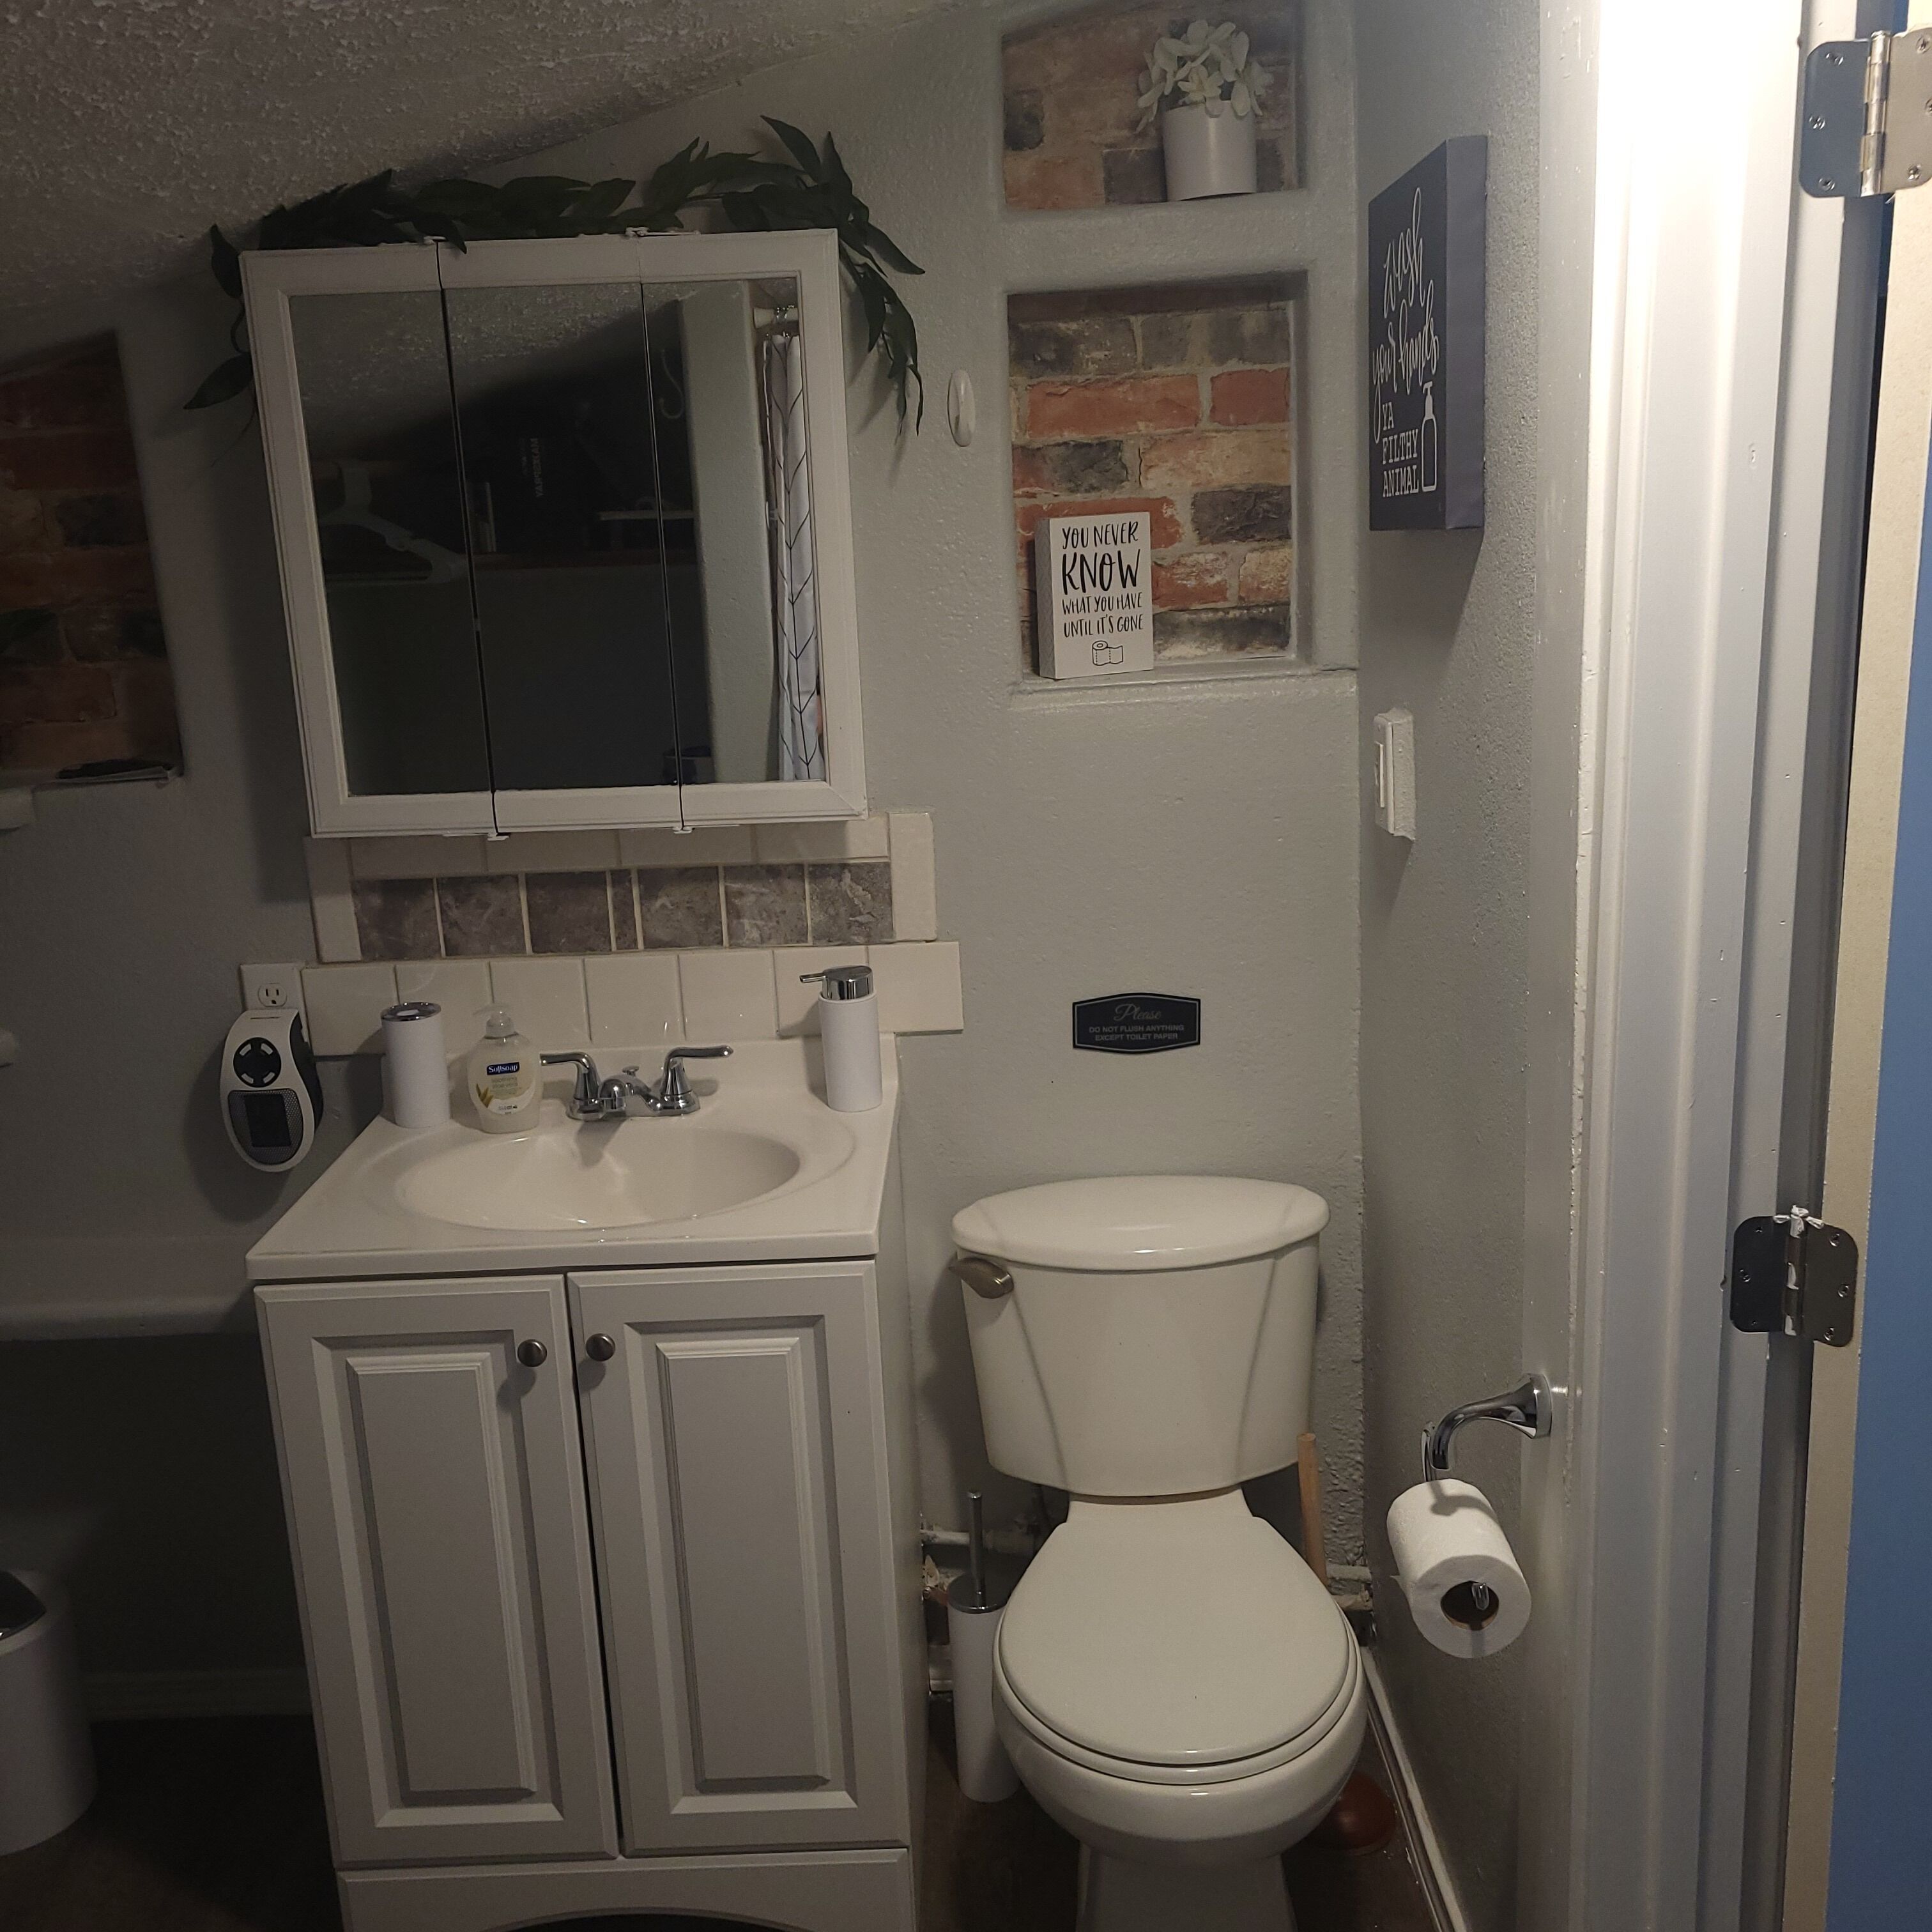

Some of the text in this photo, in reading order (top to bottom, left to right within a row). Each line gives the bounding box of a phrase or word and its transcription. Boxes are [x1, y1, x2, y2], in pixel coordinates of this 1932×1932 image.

[1372, 321, 1398, 445] your
[1382, 401, 1395, 431] YA
[1382, 427, 1418, 464] FILTHY
[1382, 464, 1420, 498] ANIMAL
[1062, 521, 1138, 549] YOU NEVER
[1062, 549, 1140, 595] KNOW
[1062, 592, 1143, 615] WHAT YOU HAVE
[1064, 618, 1094, 638] UNTIL
[1117, 613, 1144, 632] GONE
[1113, 1003, 1162, 1022] Please
[488, 1064, 518, 1073] Softsoap
